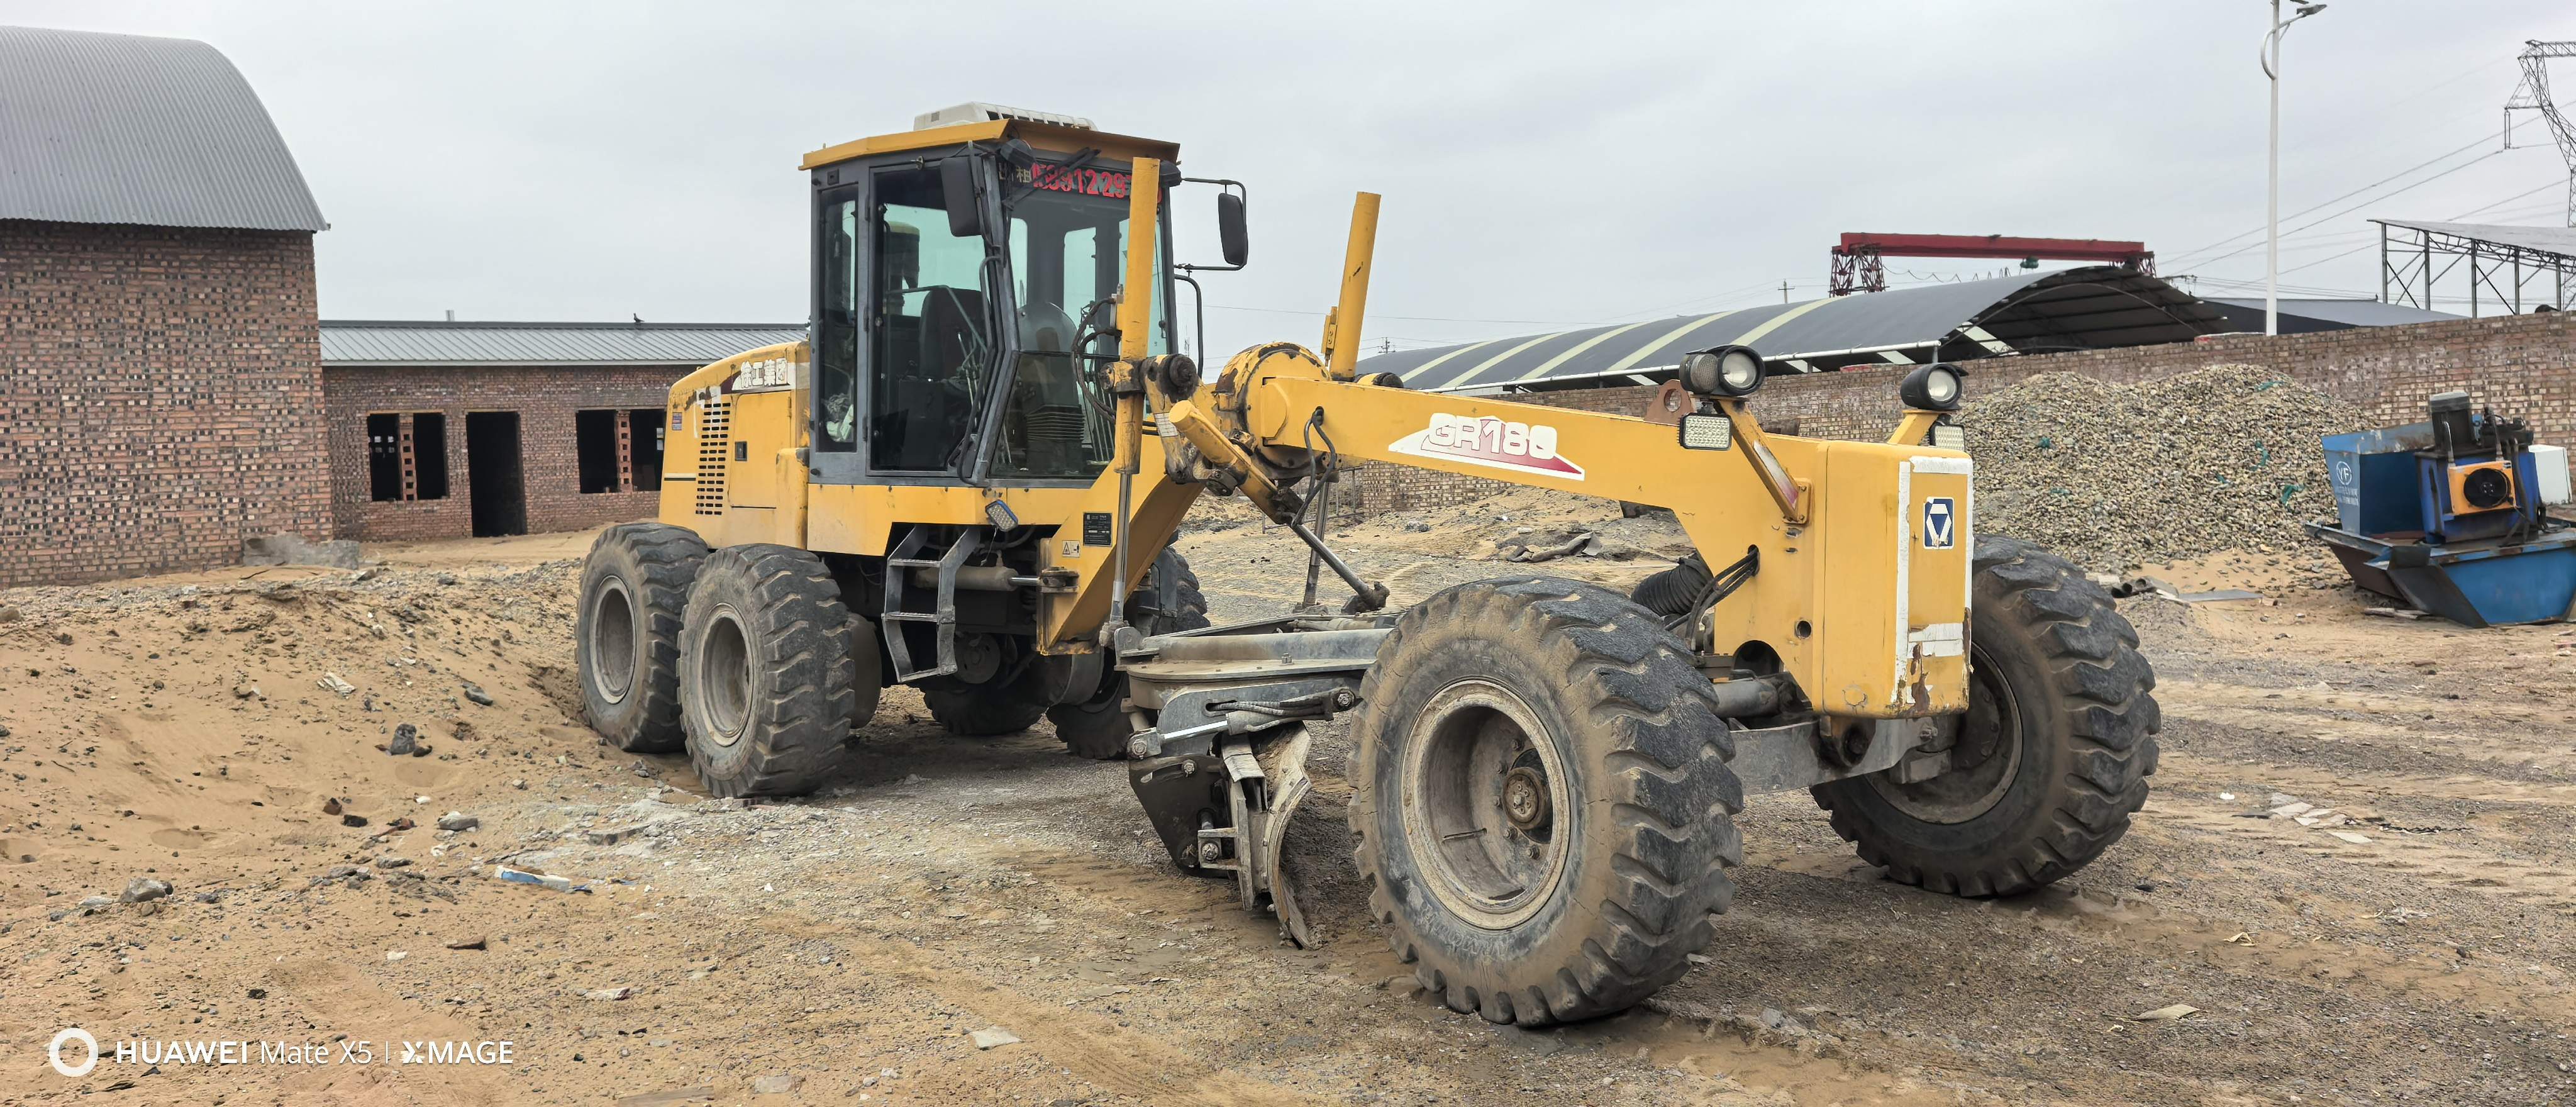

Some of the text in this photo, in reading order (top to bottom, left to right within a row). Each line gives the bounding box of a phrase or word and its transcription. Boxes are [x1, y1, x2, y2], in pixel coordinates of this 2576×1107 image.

[741, 358, 787, 388] 徐工集团
[1428, 413, 1557, 460] GR180
